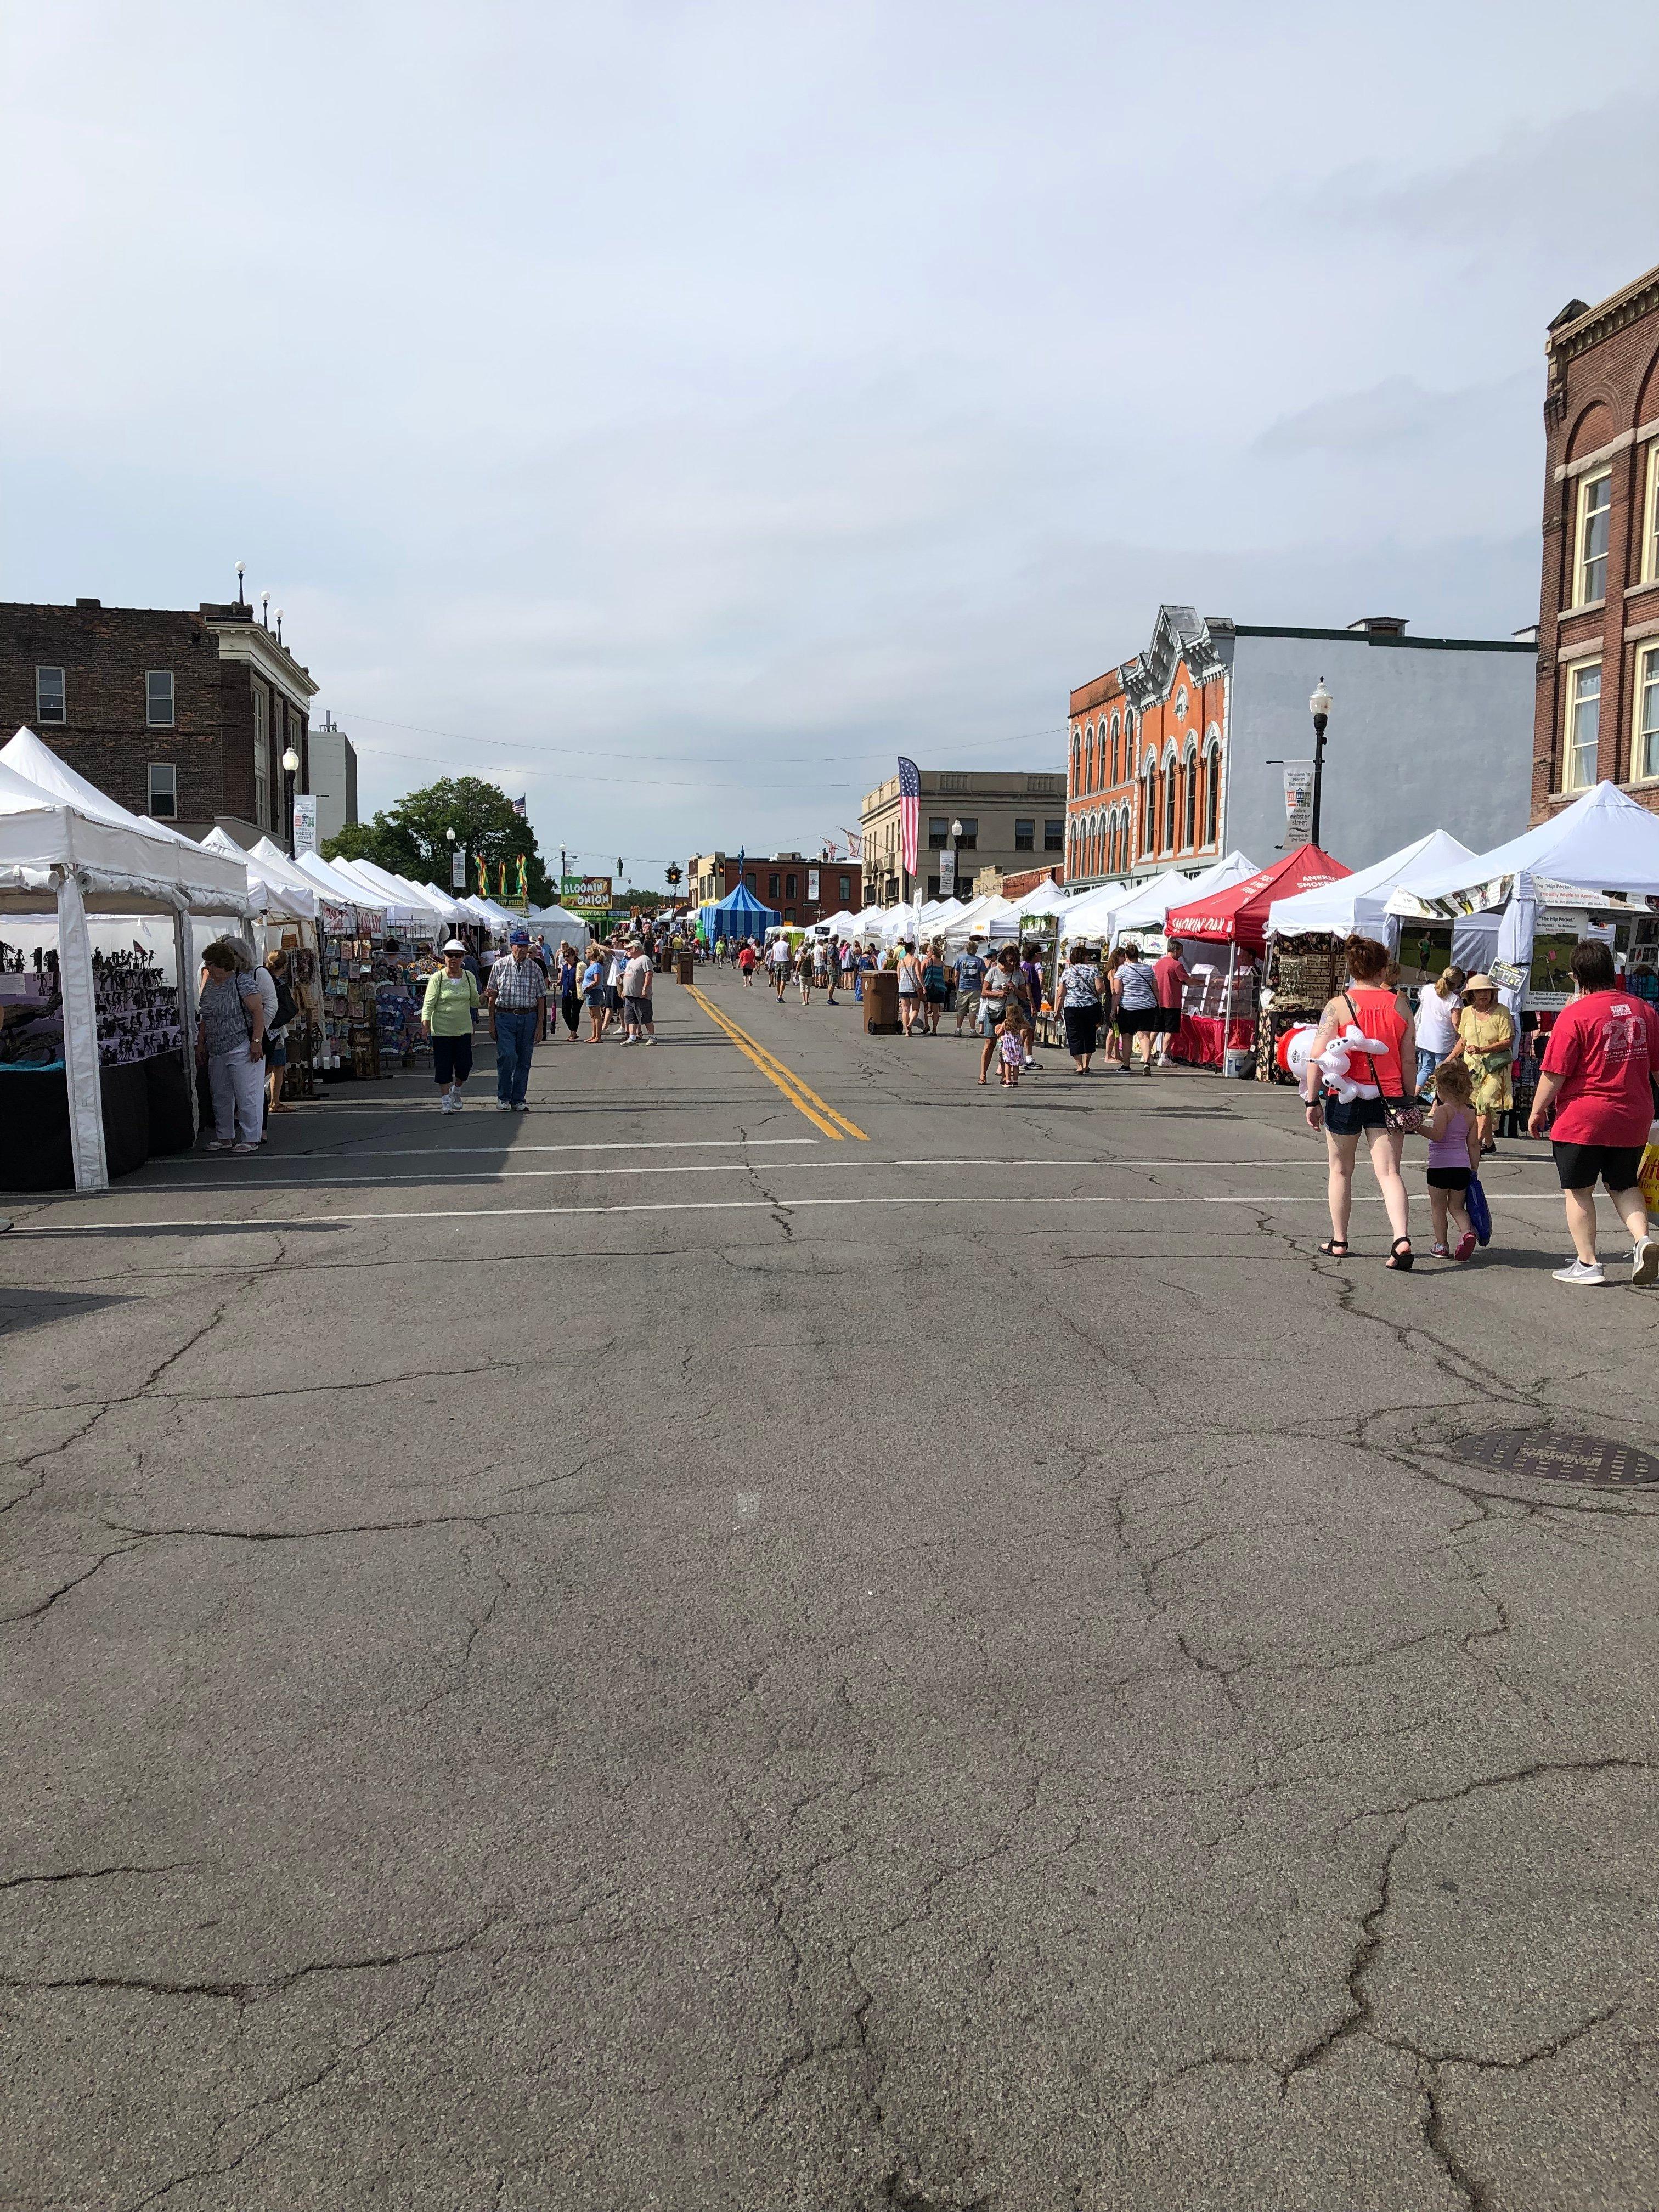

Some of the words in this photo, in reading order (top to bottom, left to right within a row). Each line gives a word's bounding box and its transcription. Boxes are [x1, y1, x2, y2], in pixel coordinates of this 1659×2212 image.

[564, 882, 602, 894] BLOOMIN
[577, 894, 608, 905] ONION
[1204, 917, 1225, 934] OAK
[1602, 1016, 1647, 1052] 20
